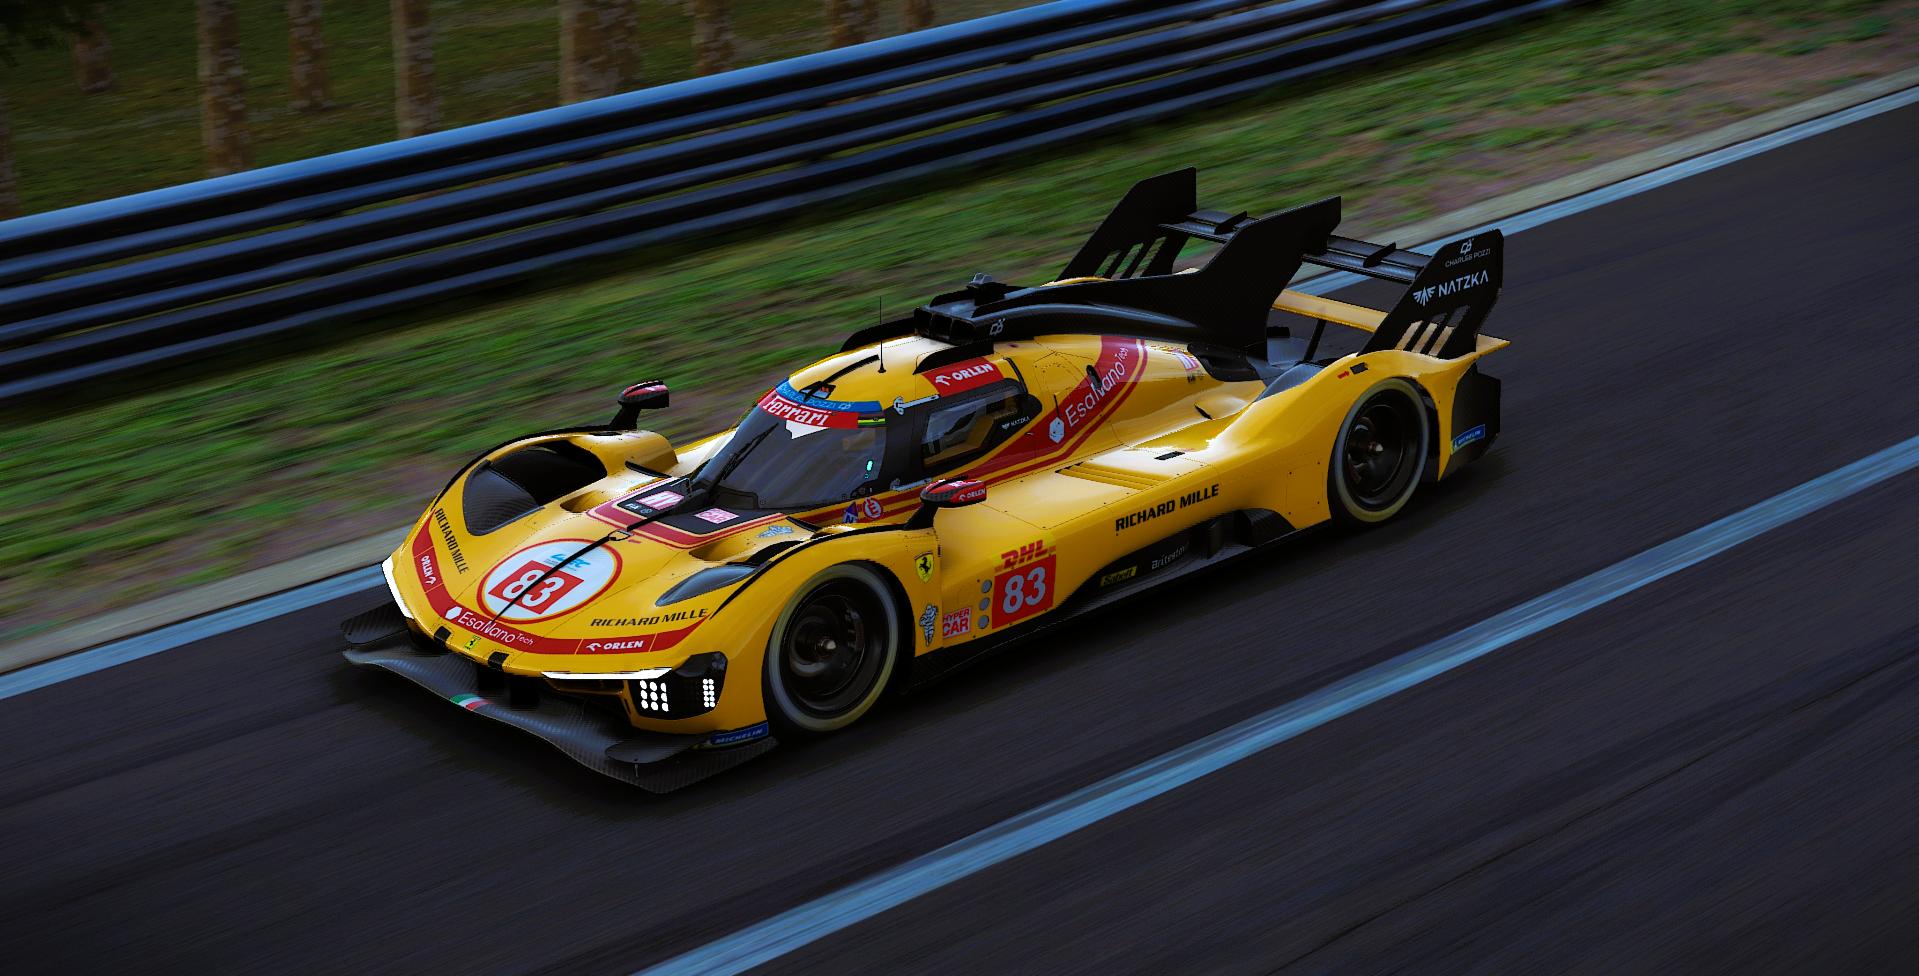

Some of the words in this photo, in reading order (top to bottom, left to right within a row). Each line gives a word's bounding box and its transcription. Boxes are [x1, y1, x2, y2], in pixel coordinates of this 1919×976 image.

[1438, 269, 1489, 298] NATZKA
[951, 363, 994, 381] ORLEN
[762, 395, 832, 426] Ferrari
[1115, 499, 1175, 532] RICHARD
[1179, 483, 1220, 509] MILLE
[434, 507, 460, 552] RICHARD
[451, 547, 470, 575] MILLE
[1001, 539, 1048, 569] DHL
[420, 555, 434, 578] ORLEN
[502, 569, 565, 607] 83
[1002, 566, 1046, 615] 83
[590, 616, 660, 627] RICHARD
[661, 608, 709, 623] MILLE
[943, 617, 969, 637] CAR
[603, 640, 644, 650] ORLEN
